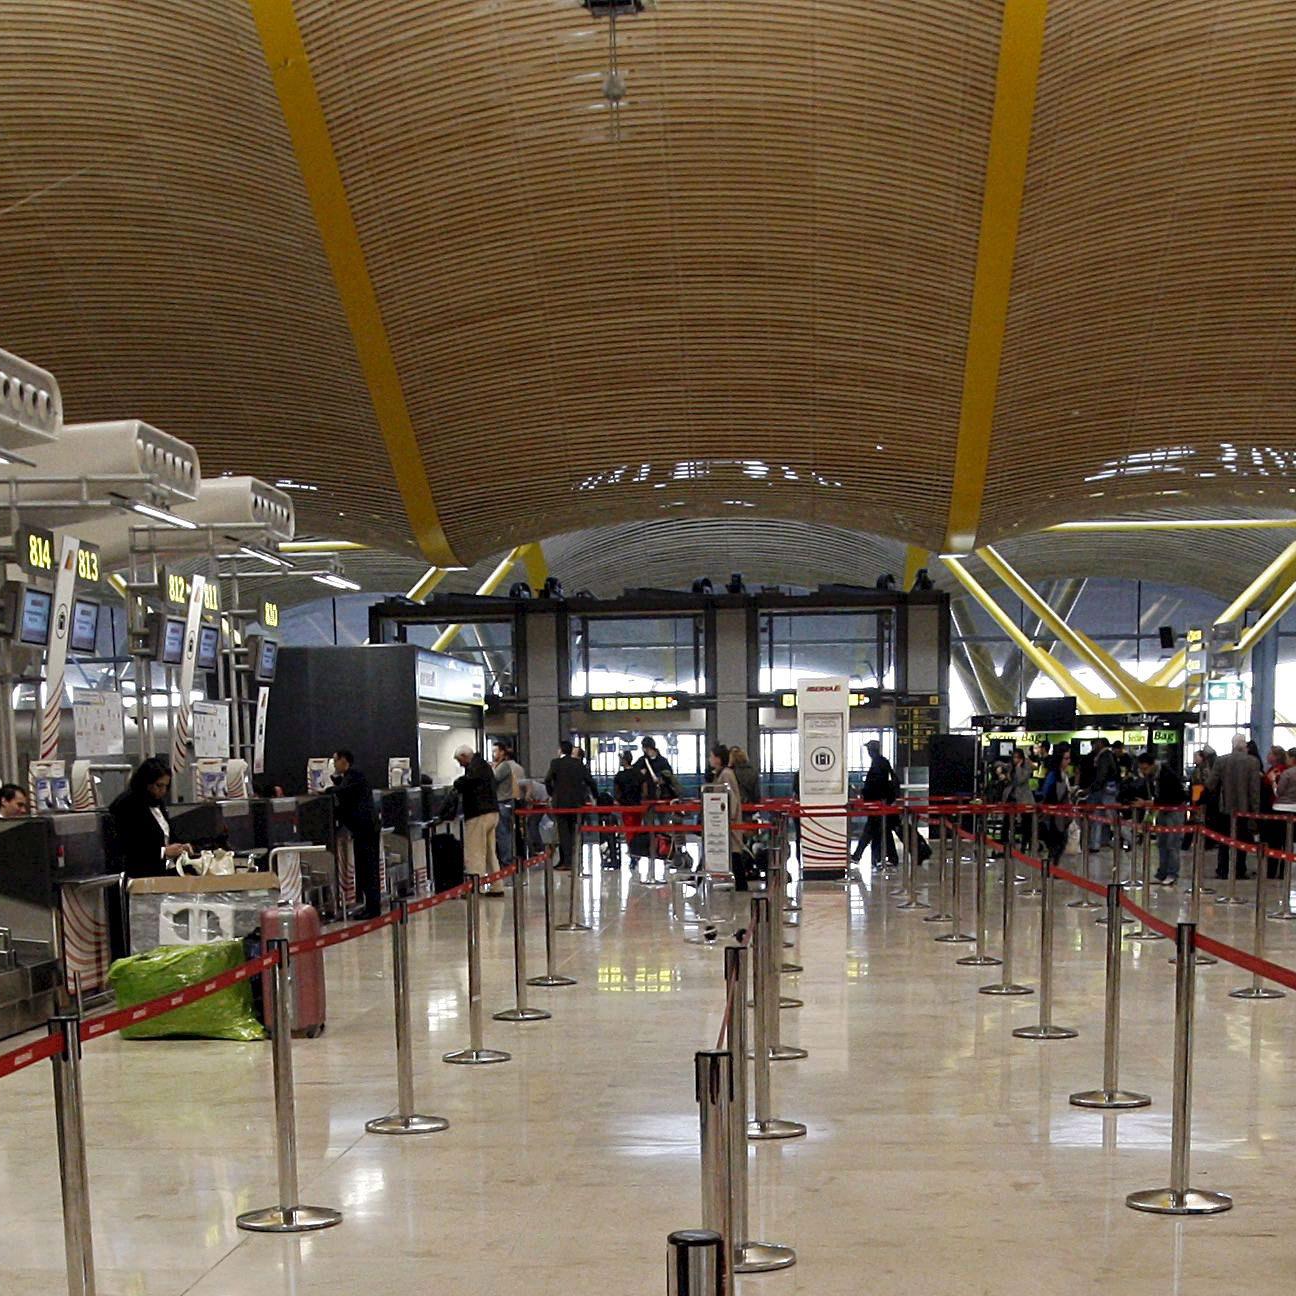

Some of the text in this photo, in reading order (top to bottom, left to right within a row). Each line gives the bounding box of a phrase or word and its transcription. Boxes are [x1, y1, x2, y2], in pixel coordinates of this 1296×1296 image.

[29, 534, 51, 570] 814
[78, 549, 99, 581] 813
[168, 574, 185, 603] 812
